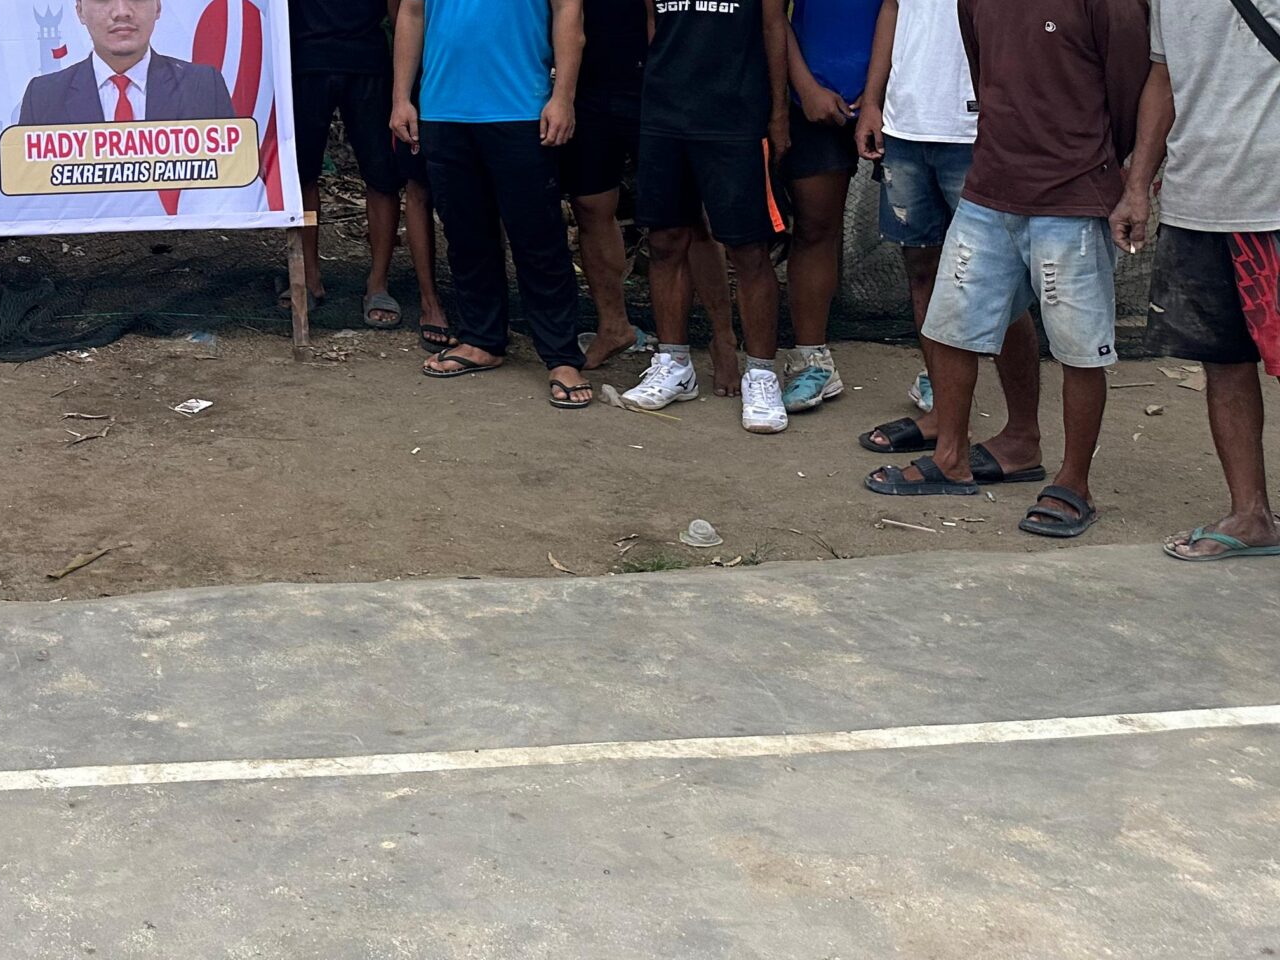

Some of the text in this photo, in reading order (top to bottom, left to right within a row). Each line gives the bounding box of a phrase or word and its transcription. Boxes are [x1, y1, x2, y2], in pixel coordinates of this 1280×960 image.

[695, 1, 740, 13] wear
[26, 126, 241, 159] HADY PRANOTO S.P
[52, 159, 217, 184] SEKRETARIS PANITIA
